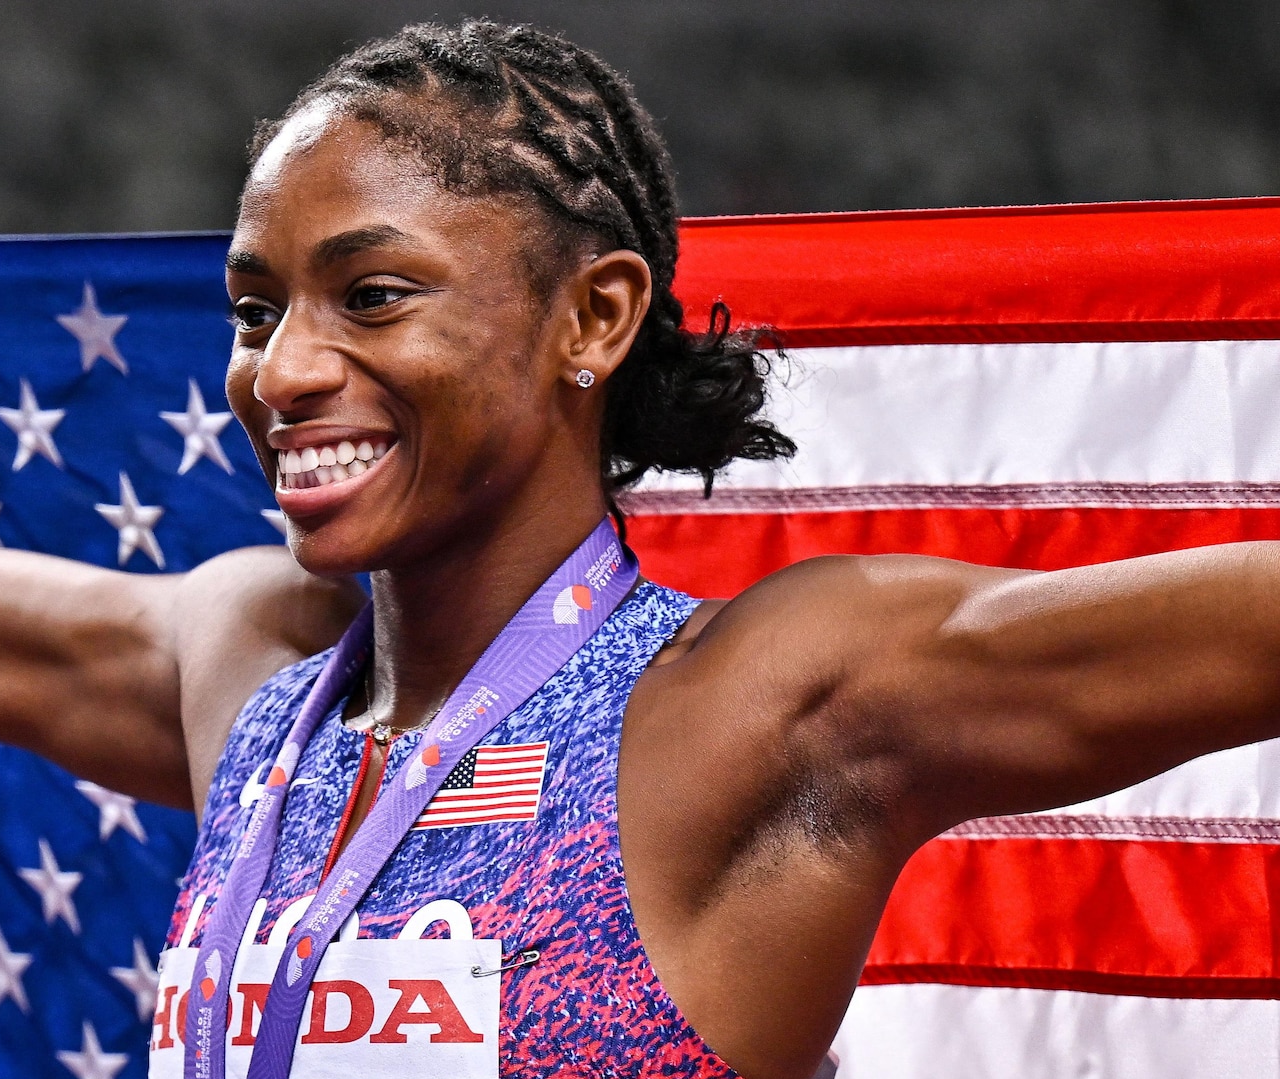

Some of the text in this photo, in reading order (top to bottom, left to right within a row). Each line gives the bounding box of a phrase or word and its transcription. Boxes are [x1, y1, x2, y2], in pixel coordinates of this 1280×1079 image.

[435, 684, 488, 738] WORLD ATHLETICS
[439, 688, 493, 741] CHAMPIONSHIPS
[259, 793, 276, 820] WORLD
[306, 904, 325, 929] WORLD
